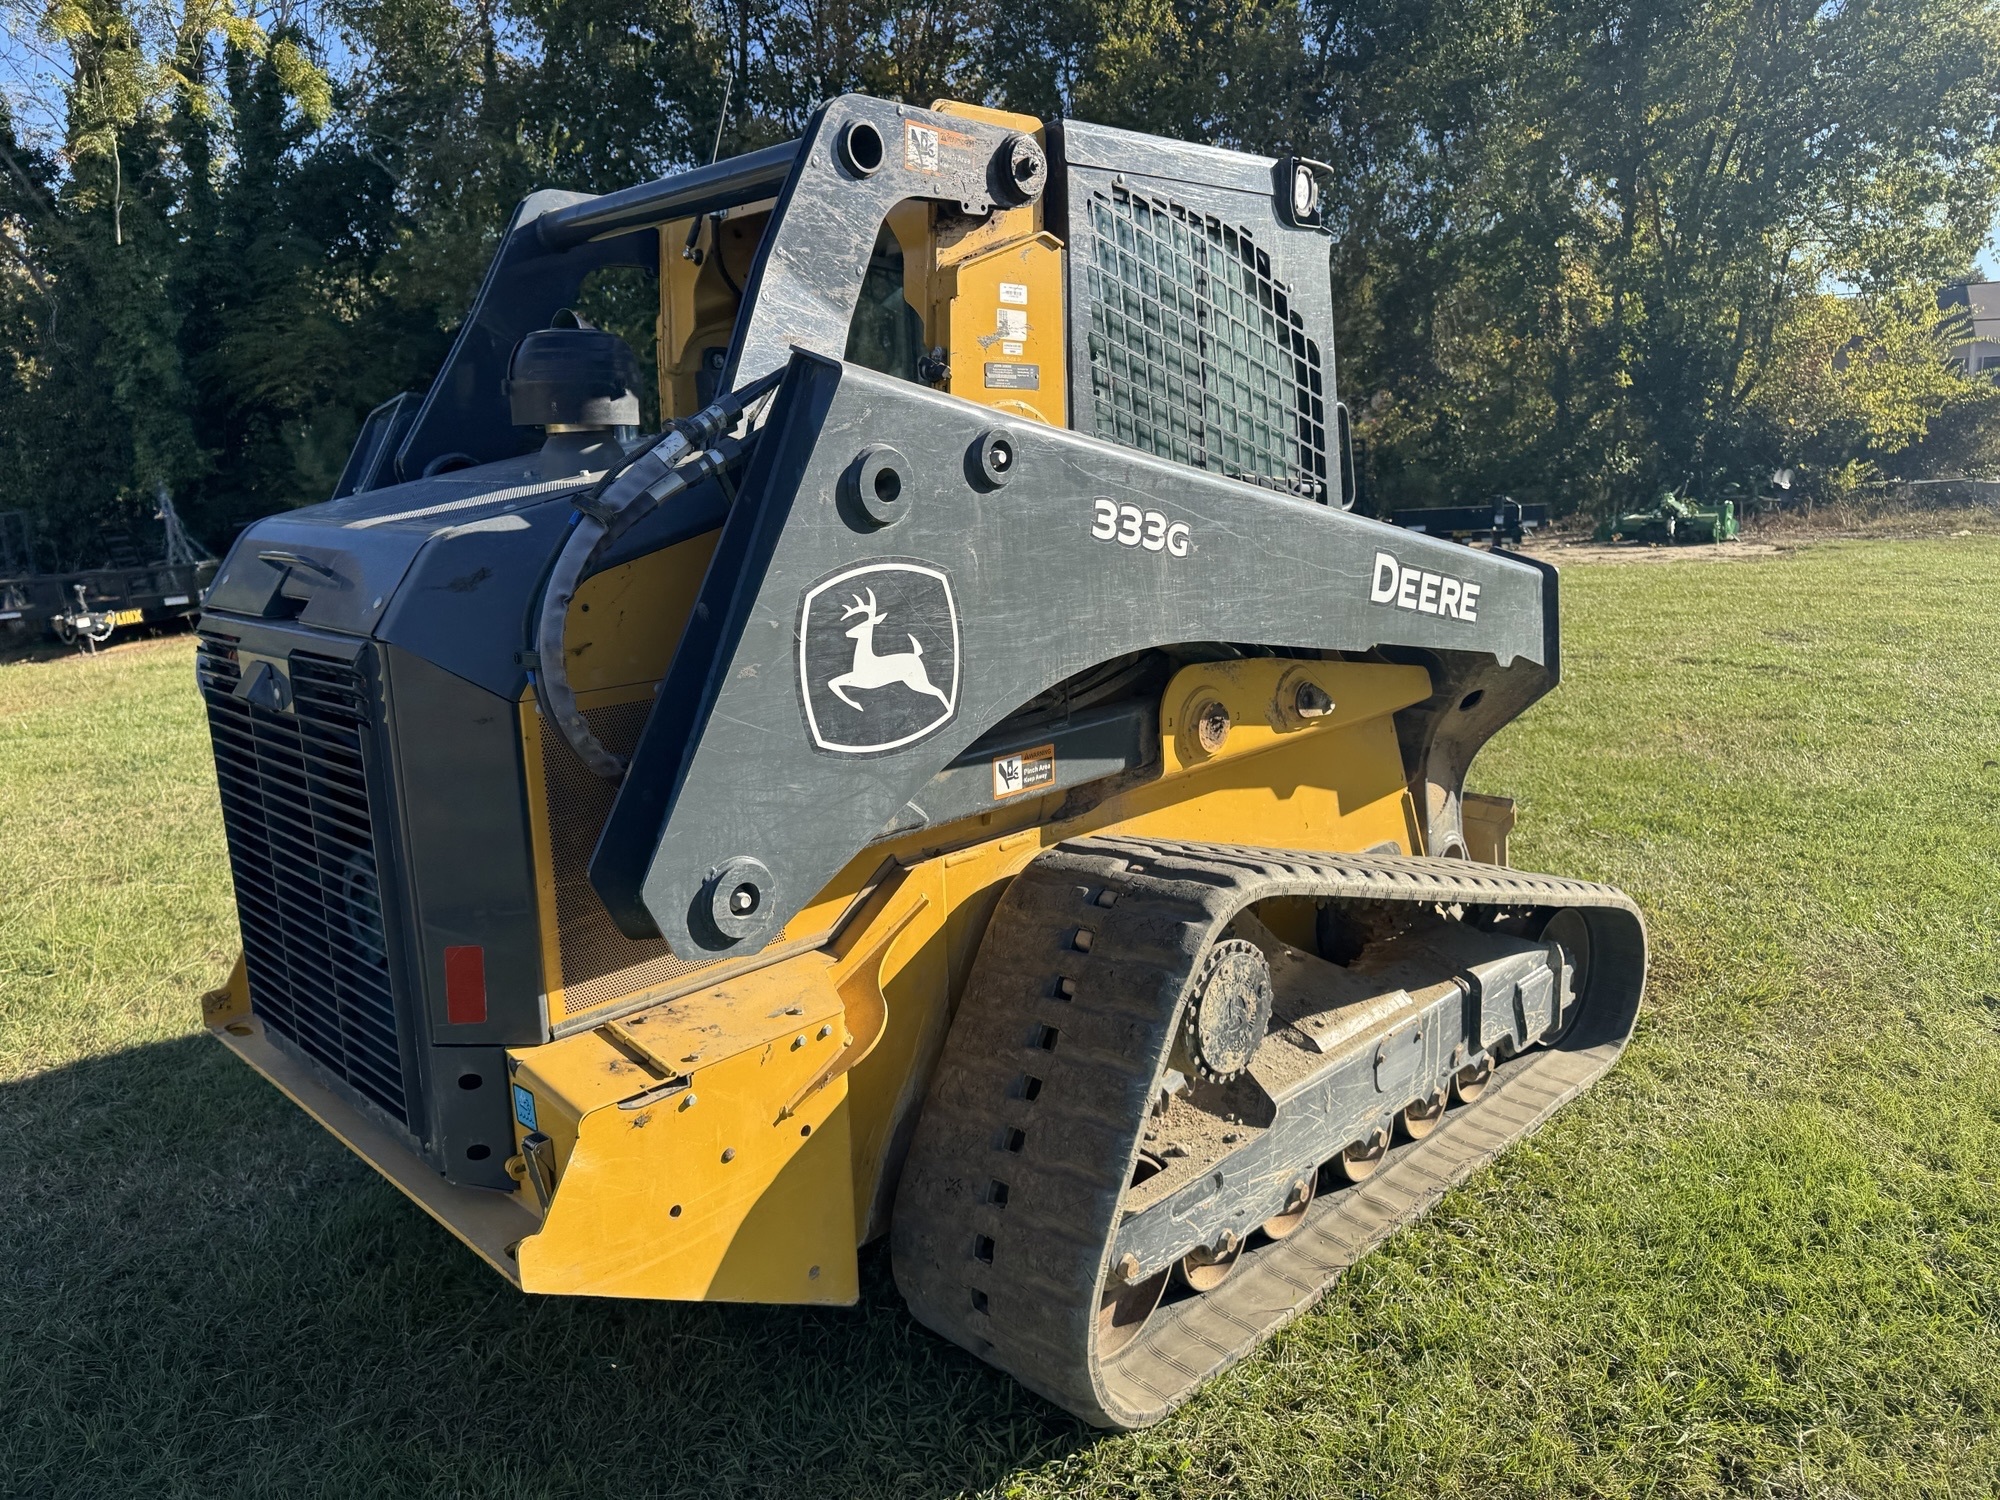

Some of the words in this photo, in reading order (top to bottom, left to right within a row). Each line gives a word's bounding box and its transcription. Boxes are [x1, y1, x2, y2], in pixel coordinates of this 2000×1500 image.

[1092, 499, 1190, 557] 333G
[1370, 552, 1481, 622] DEERE
[1028, 749, 1052, 760] WARNING
[1023, 766, 1039, 776] Pinch
[1038, 763, 1051, 772] Area
[1023, 775, 1036, 784] Keep
[1035, 773, 1048, 781] Away
